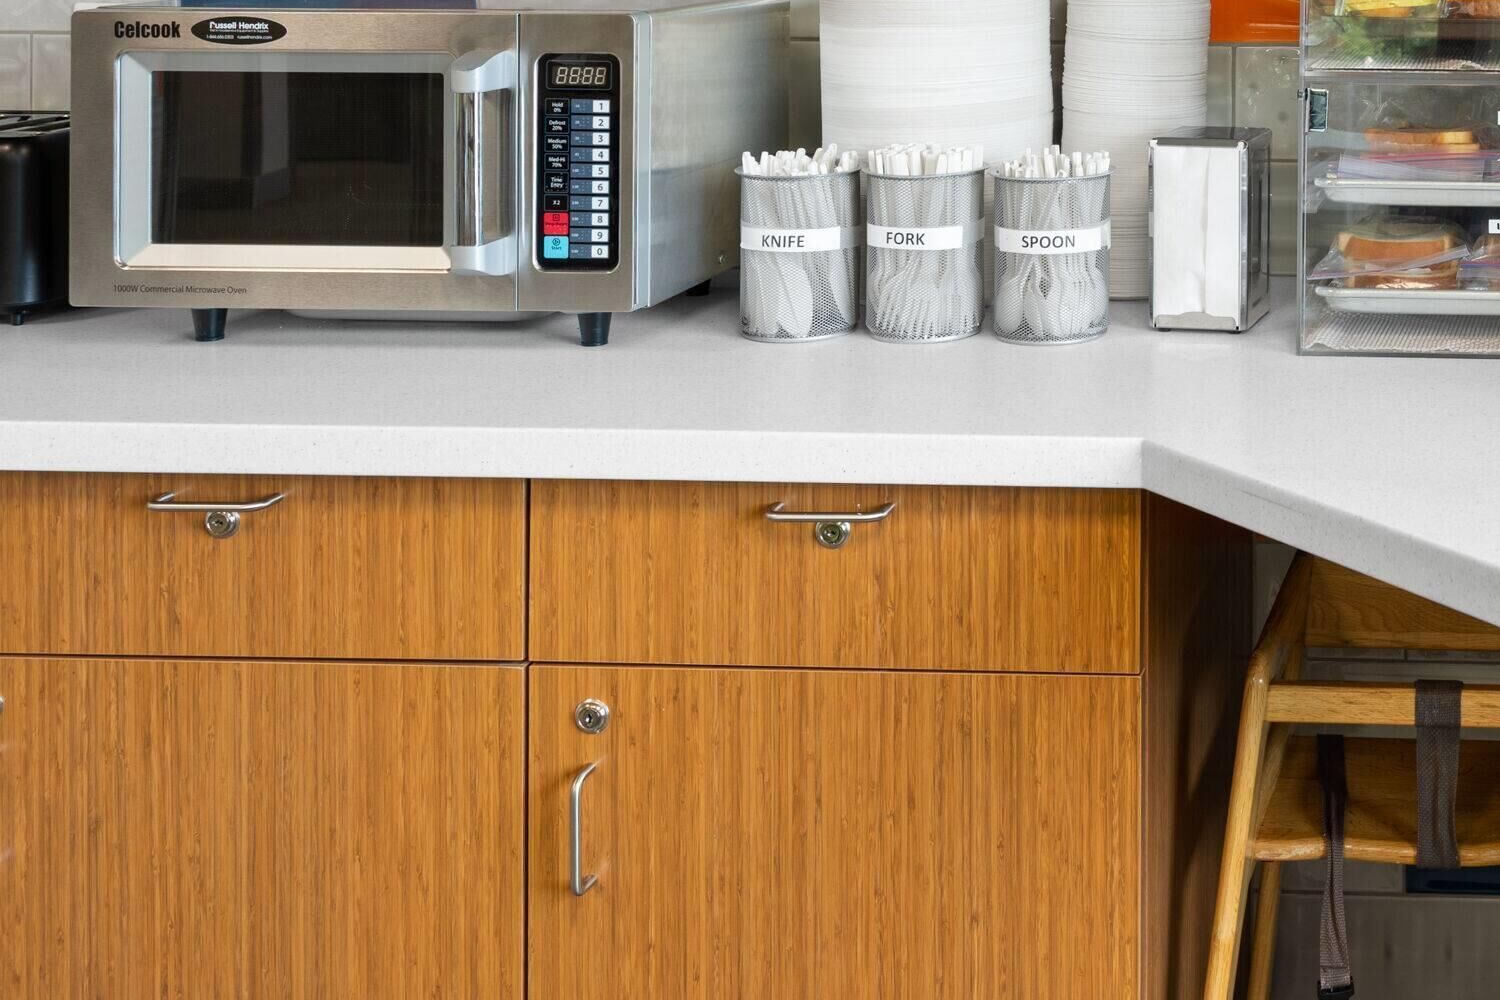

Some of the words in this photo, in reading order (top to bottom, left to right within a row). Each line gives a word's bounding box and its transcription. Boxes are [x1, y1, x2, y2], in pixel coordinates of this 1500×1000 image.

[114, 21, 181, 38] Celcook
[209, 21, 236, 30] Russell
[238, 21, 269, 30] Hendrix
[598, 119, 604, 127] 2
[598, 135, 603, 143] 3
[598, 167, 603, 175] 5
[597, 183, 603, 191] 6
[597, 215, 603, 223] 8
[597, 231, 602, 239] 9
[886, 231, 926, 246] FORK
[761, 234, 805, 249] KNIFE
[1021, 234, 1076, 249] SPOON
[597, 247, 602, 255] 0
[113, 284, 138, 293] 1000W
[140, 284, 184, 293] Commercial
[186, 285, 226, 294] Microwave
[227, 286, 247, 294] Oven
